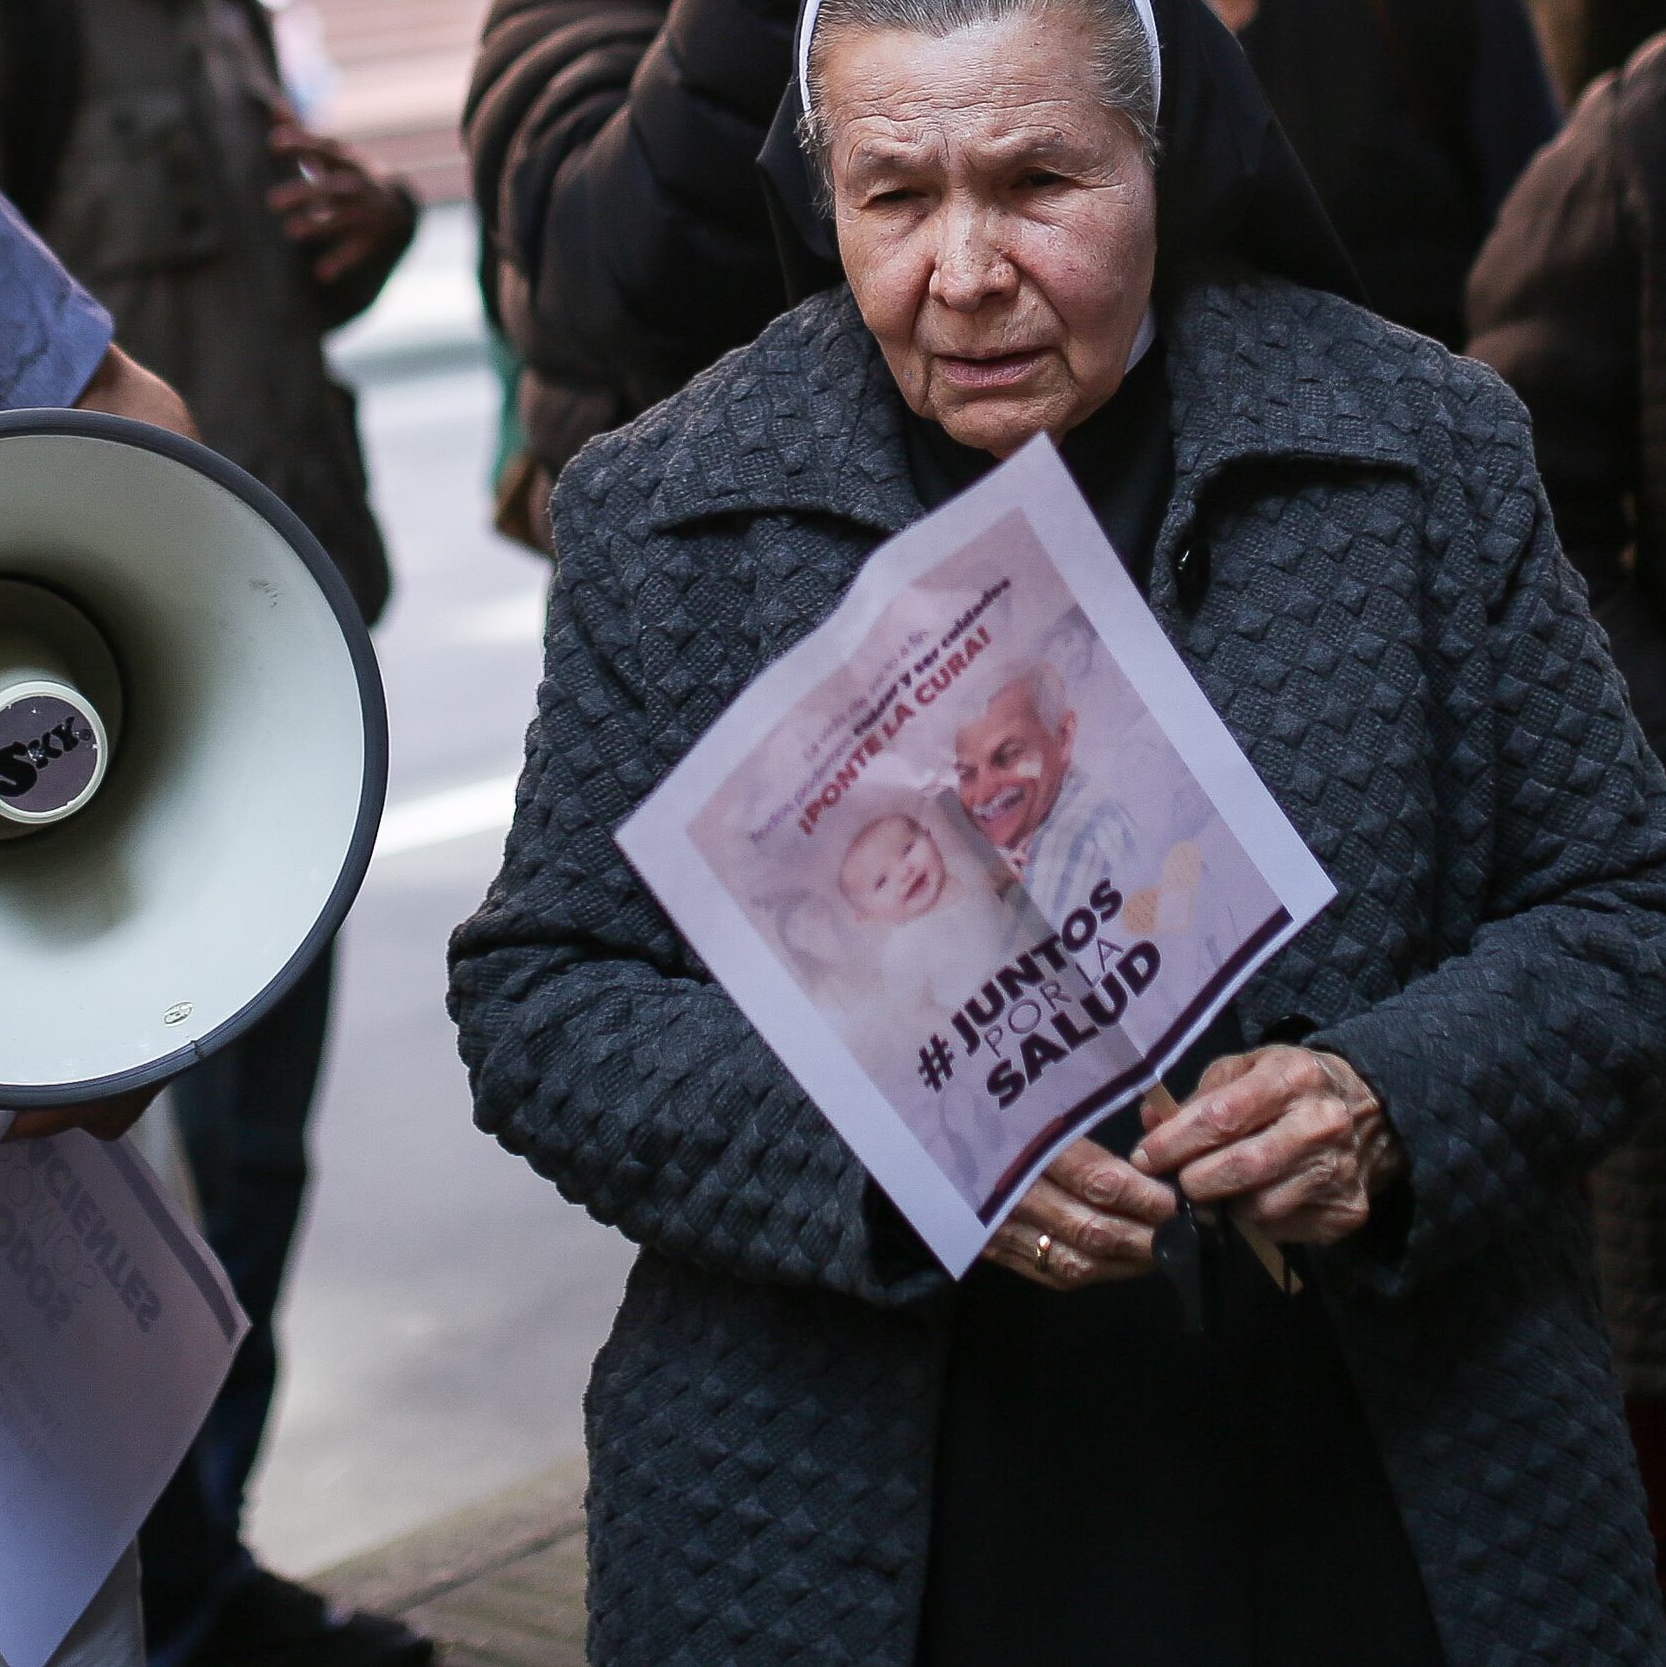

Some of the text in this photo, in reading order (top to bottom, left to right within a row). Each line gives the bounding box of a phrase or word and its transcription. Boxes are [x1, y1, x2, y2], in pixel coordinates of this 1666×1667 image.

[882, 702, 916, 740] LA
[984, 937, 1124, 1059] POR LA
[987, 940, 1162, 1111] SALUD
